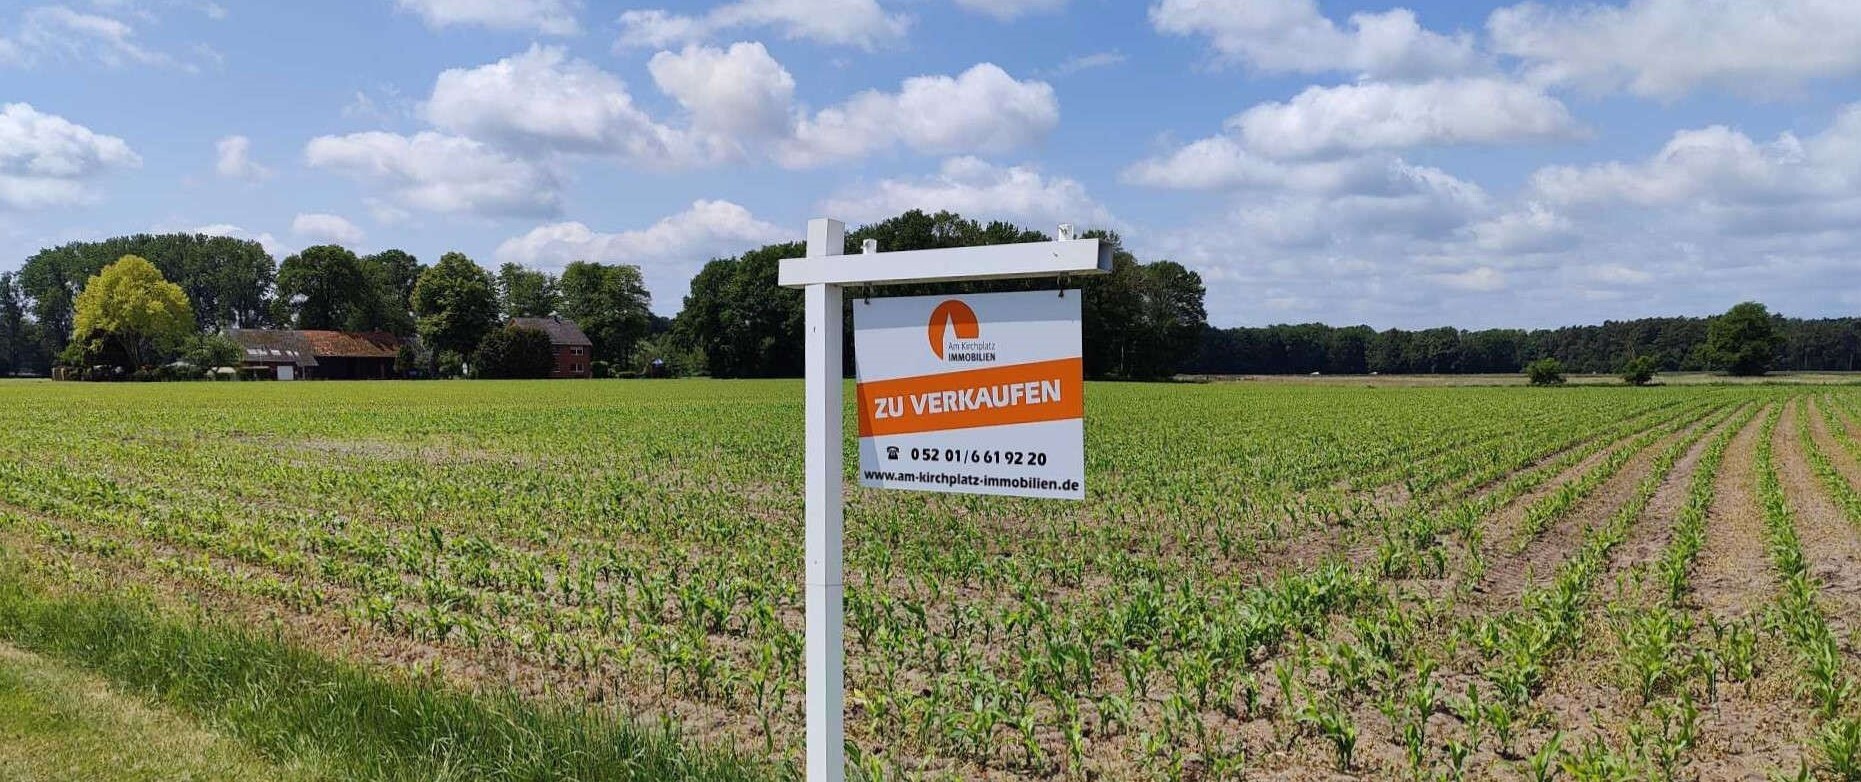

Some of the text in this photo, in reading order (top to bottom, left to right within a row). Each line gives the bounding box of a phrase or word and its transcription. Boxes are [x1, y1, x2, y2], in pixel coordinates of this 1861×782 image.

[948, 341, 996, 352] Am Kirchplatz
[948, 352, 996, 362] IMMOBILIEN
[874, 379, 1061, 419] ZU VERKAUFEN
[864, 470, 1079, 491] www.am-kirchplatz-immobilien.de
